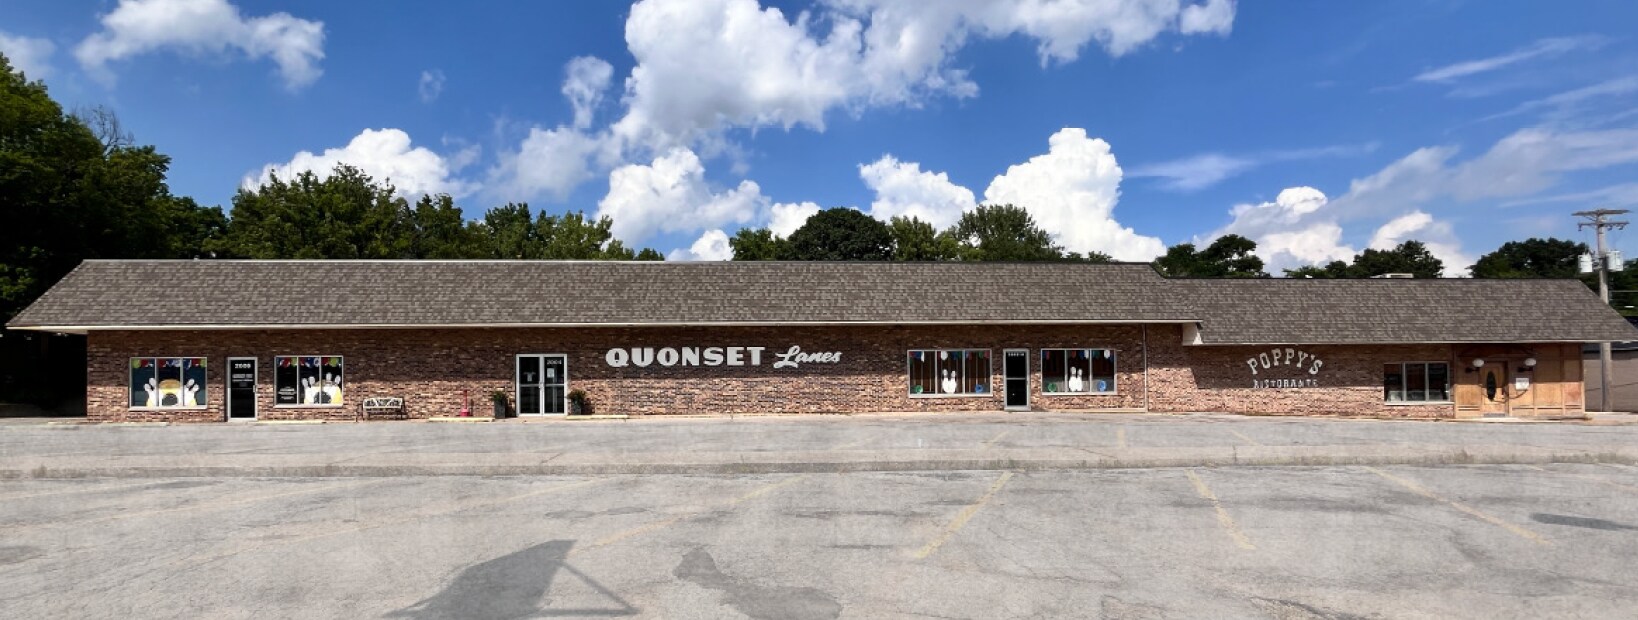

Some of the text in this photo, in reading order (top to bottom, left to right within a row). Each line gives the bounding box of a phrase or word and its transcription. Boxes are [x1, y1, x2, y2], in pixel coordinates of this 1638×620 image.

[605, 345, 842, 368] QUONSET Lanes
[1246, 348, 1323, 375] POPPY'S
[1253, 379, 1319, 388] RISTORANTE
